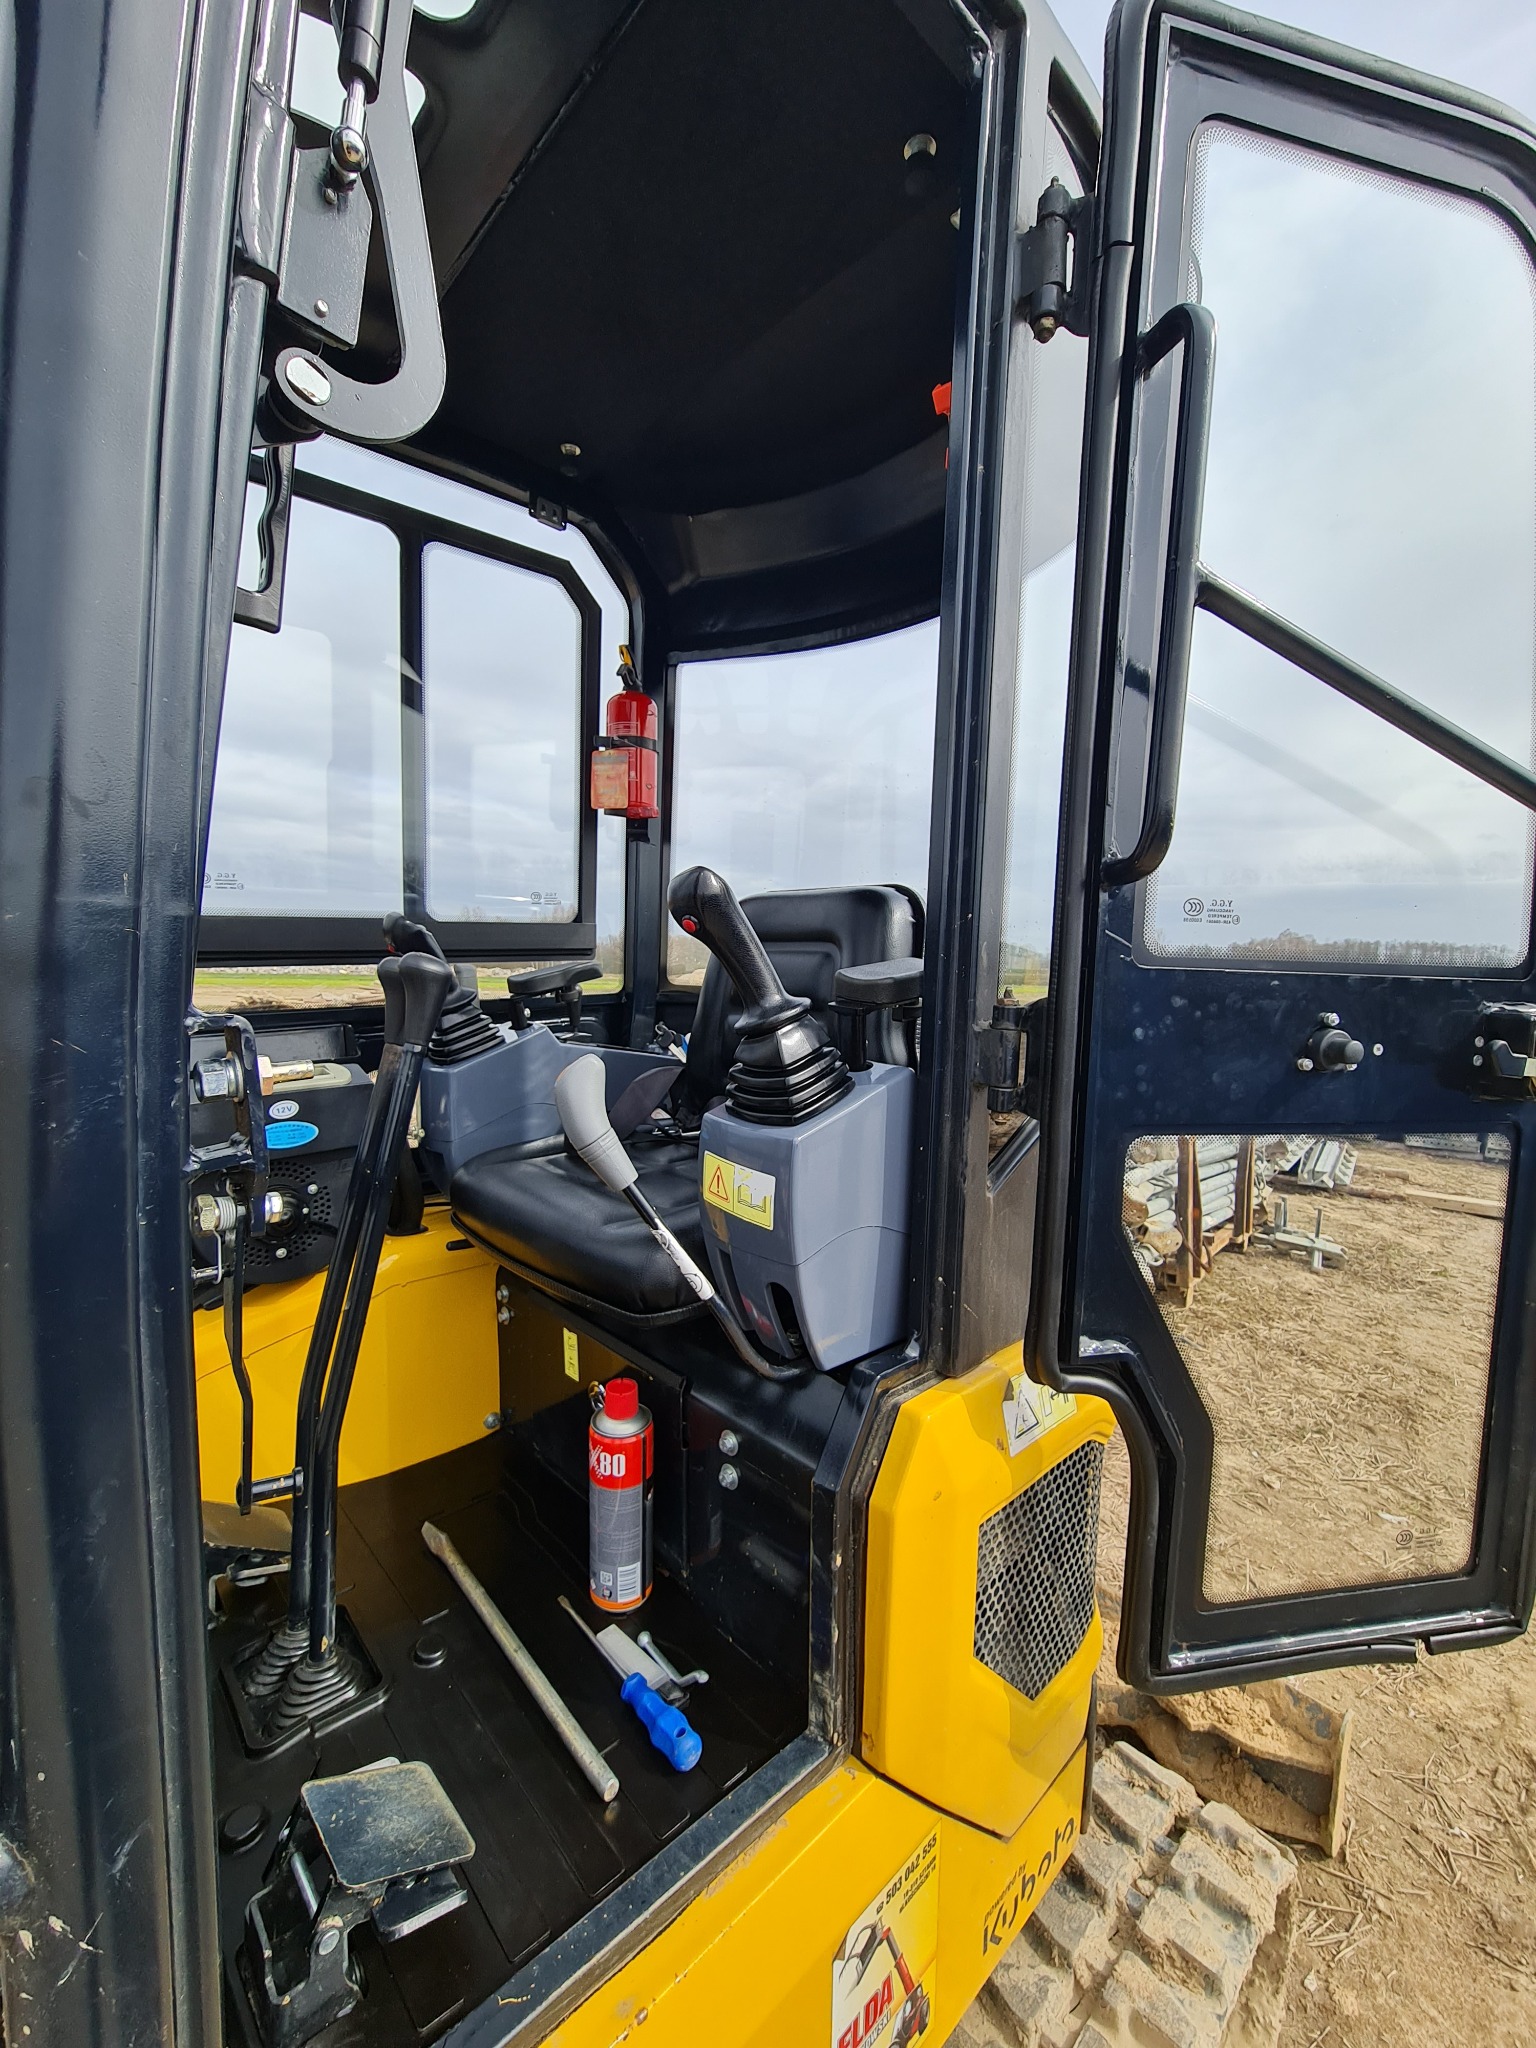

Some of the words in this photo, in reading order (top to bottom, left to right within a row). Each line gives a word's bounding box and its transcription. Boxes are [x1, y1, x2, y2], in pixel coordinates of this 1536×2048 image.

[276, 1105, 293, 1114] 12V
[886, 1875, 903, 1905] 503
[904, 1853, 920, 1882] 042
[922, 1832, 937, 1860] 555
[983, 1817, 1075, 1956] Kubota
[984, 1870, 1018, 1926] powered
[1018, 1860, 1027, 1877] by
